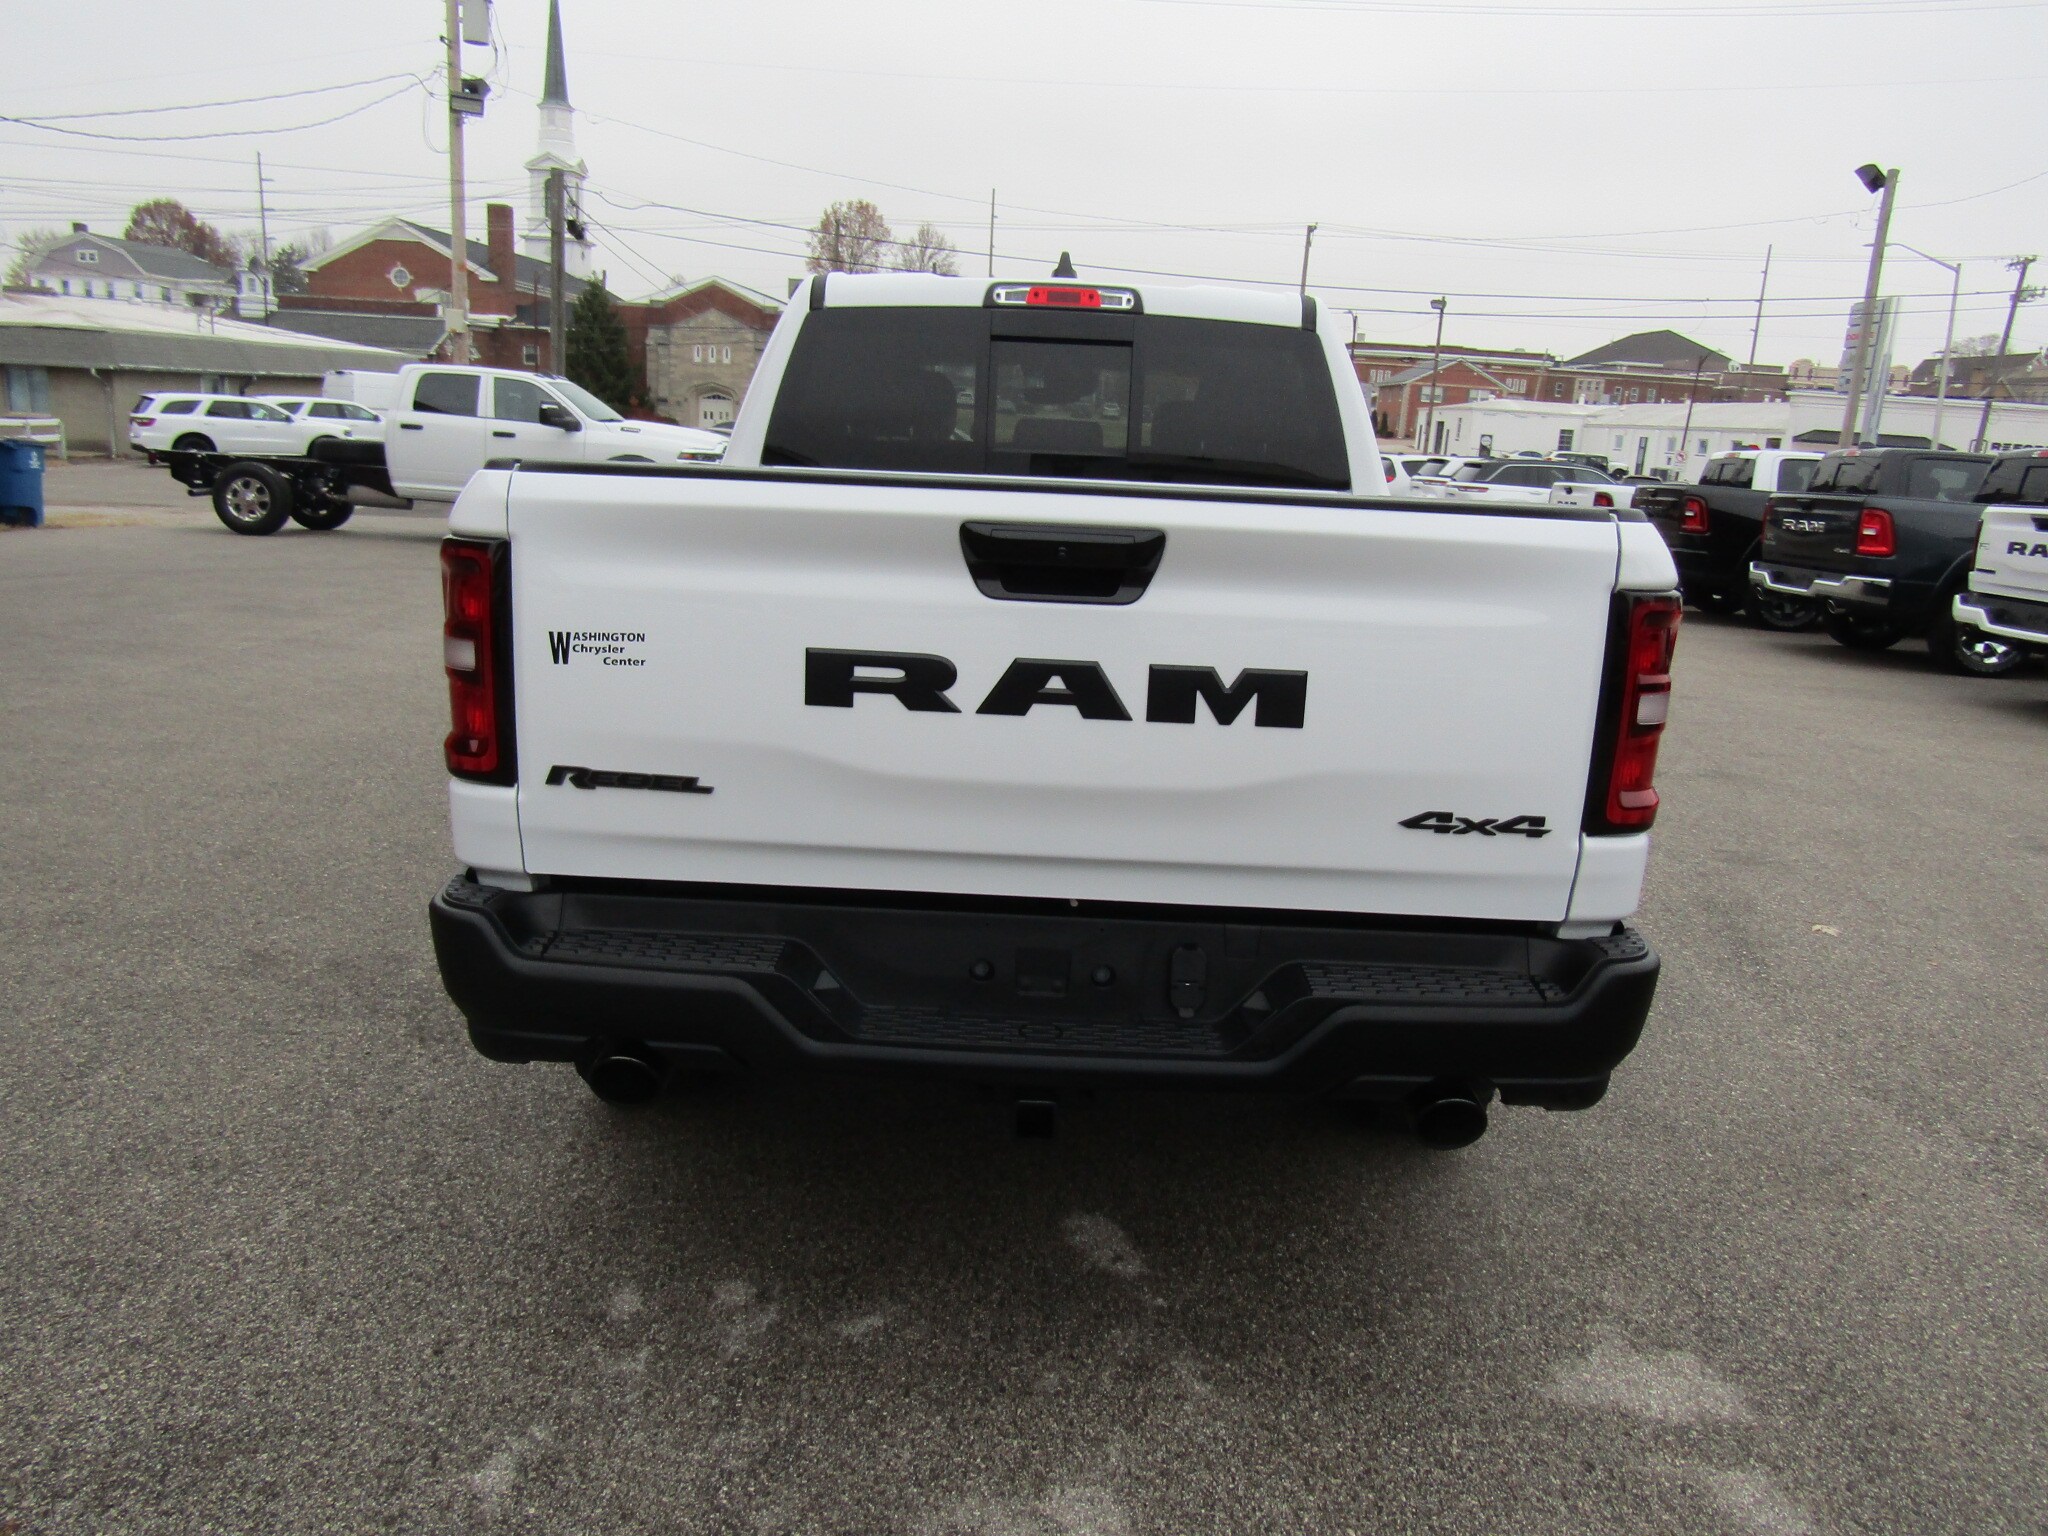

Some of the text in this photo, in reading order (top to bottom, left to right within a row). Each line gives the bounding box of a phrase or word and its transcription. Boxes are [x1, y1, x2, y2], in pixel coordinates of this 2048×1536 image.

[1782, 518, 1826, 533] RAM
[572, 643, 626, 656] Chrysler
[602, 656, 647, 666] Center
[804, 647, 1308, 728] RAM
[1397, 810, 1553, 838] 4x4
